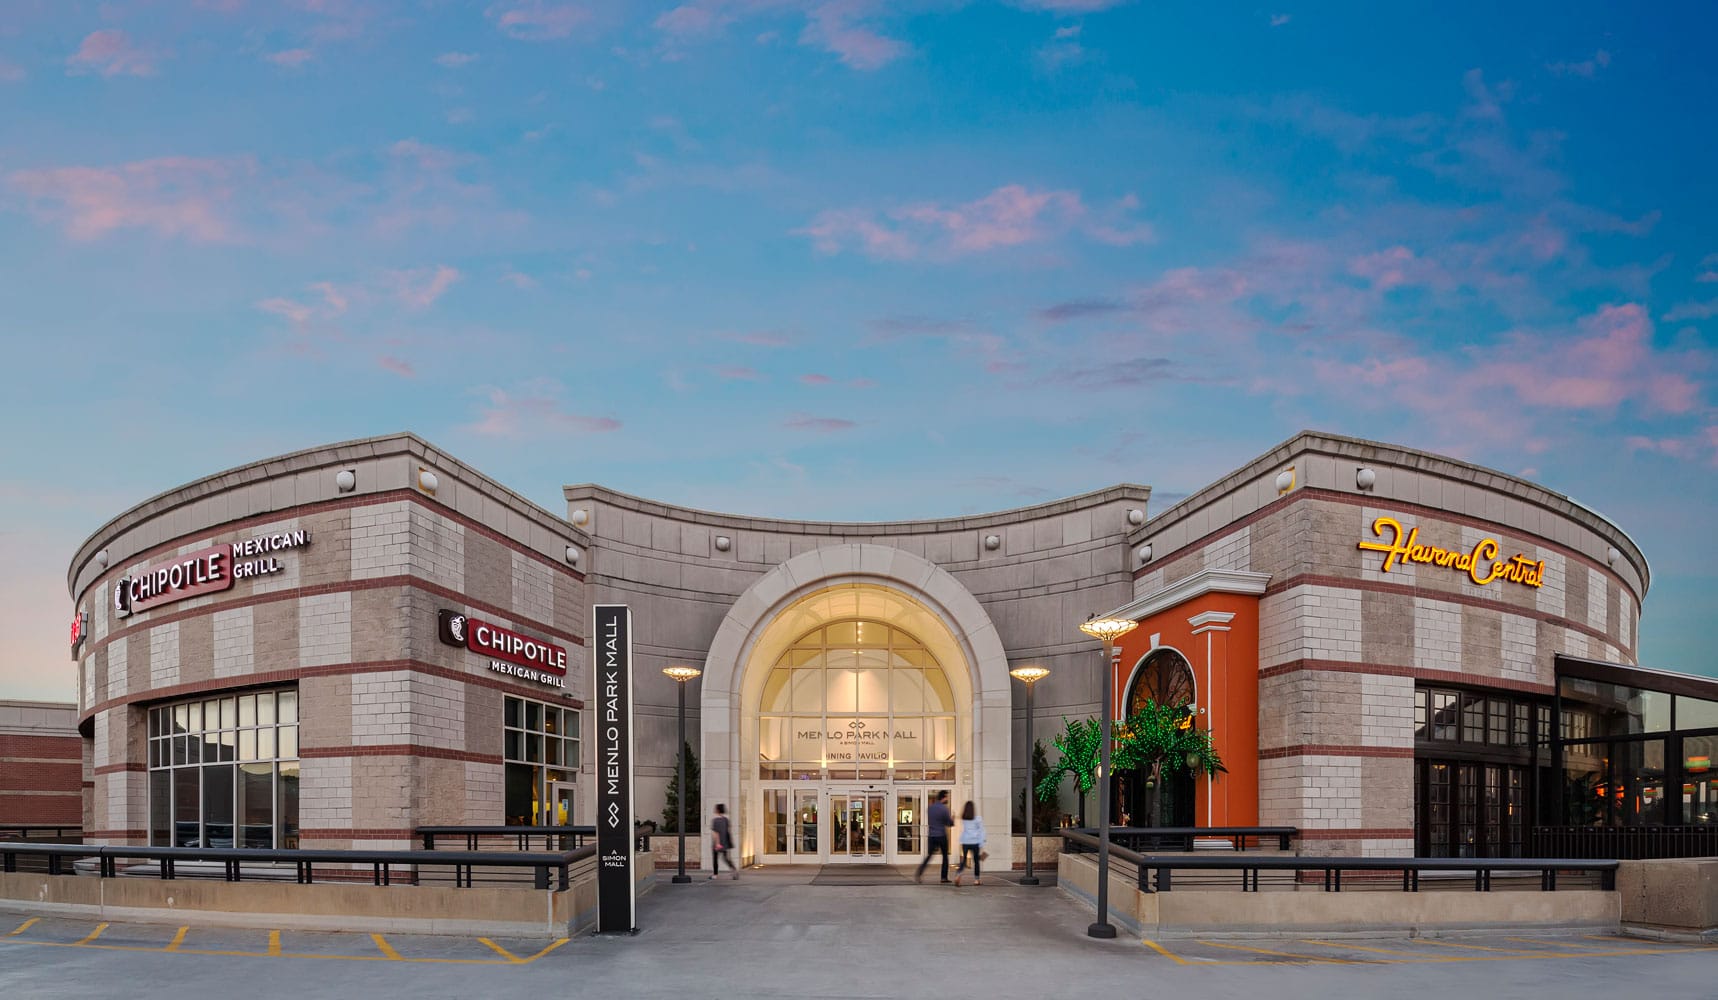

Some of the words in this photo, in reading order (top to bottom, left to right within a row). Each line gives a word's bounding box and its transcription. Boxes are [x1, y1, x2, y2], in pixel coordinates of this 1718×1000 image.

[233, 530, 304, 557] MEXICAN
[1359, 517, 1472, 572] Havana
[1470, 538, 1545, 588] Central
[130, 553, 220, 601] CHIPOTLE
[233, 558, 278, 579] GRILL
[476, 626, 566, 669] CHIPOTLE
[605, 615, 617, 667] MALL
[491, 660, 537, 681] MEXICAN
[540, 673, 566, 688] GRILL
[606, 671, 619, 722] PARK
[846, 731, 880, 739] PARK
[606, 726, 619, 794] MENLO
